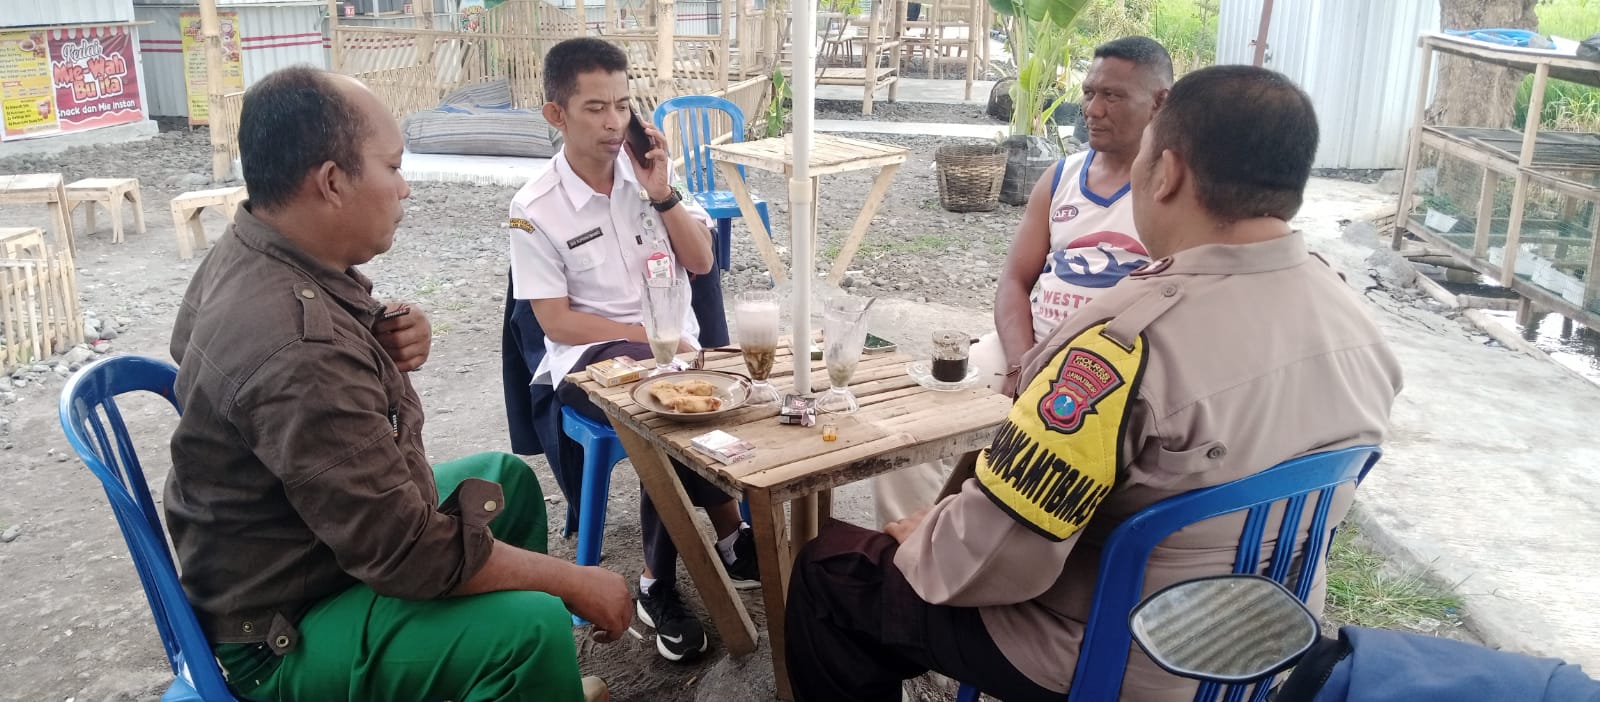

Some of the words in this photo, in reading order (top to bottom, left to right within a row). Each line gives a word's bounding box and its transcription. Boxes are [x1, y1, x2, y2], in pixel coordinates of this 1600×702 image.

[62, 40, 102, 62] Kedai
[53, 54, 124, 84] Mie-Wah
[73, 79, 97, 100] Bu
[82, 105, 97, 114] dan
[113, 100, 136, 110] Instan
[1054, 208, 1076, 219] AFL
[1067, 371, 1083, 382] JAWA
[1075, 355, 1111, 380] POLRES
